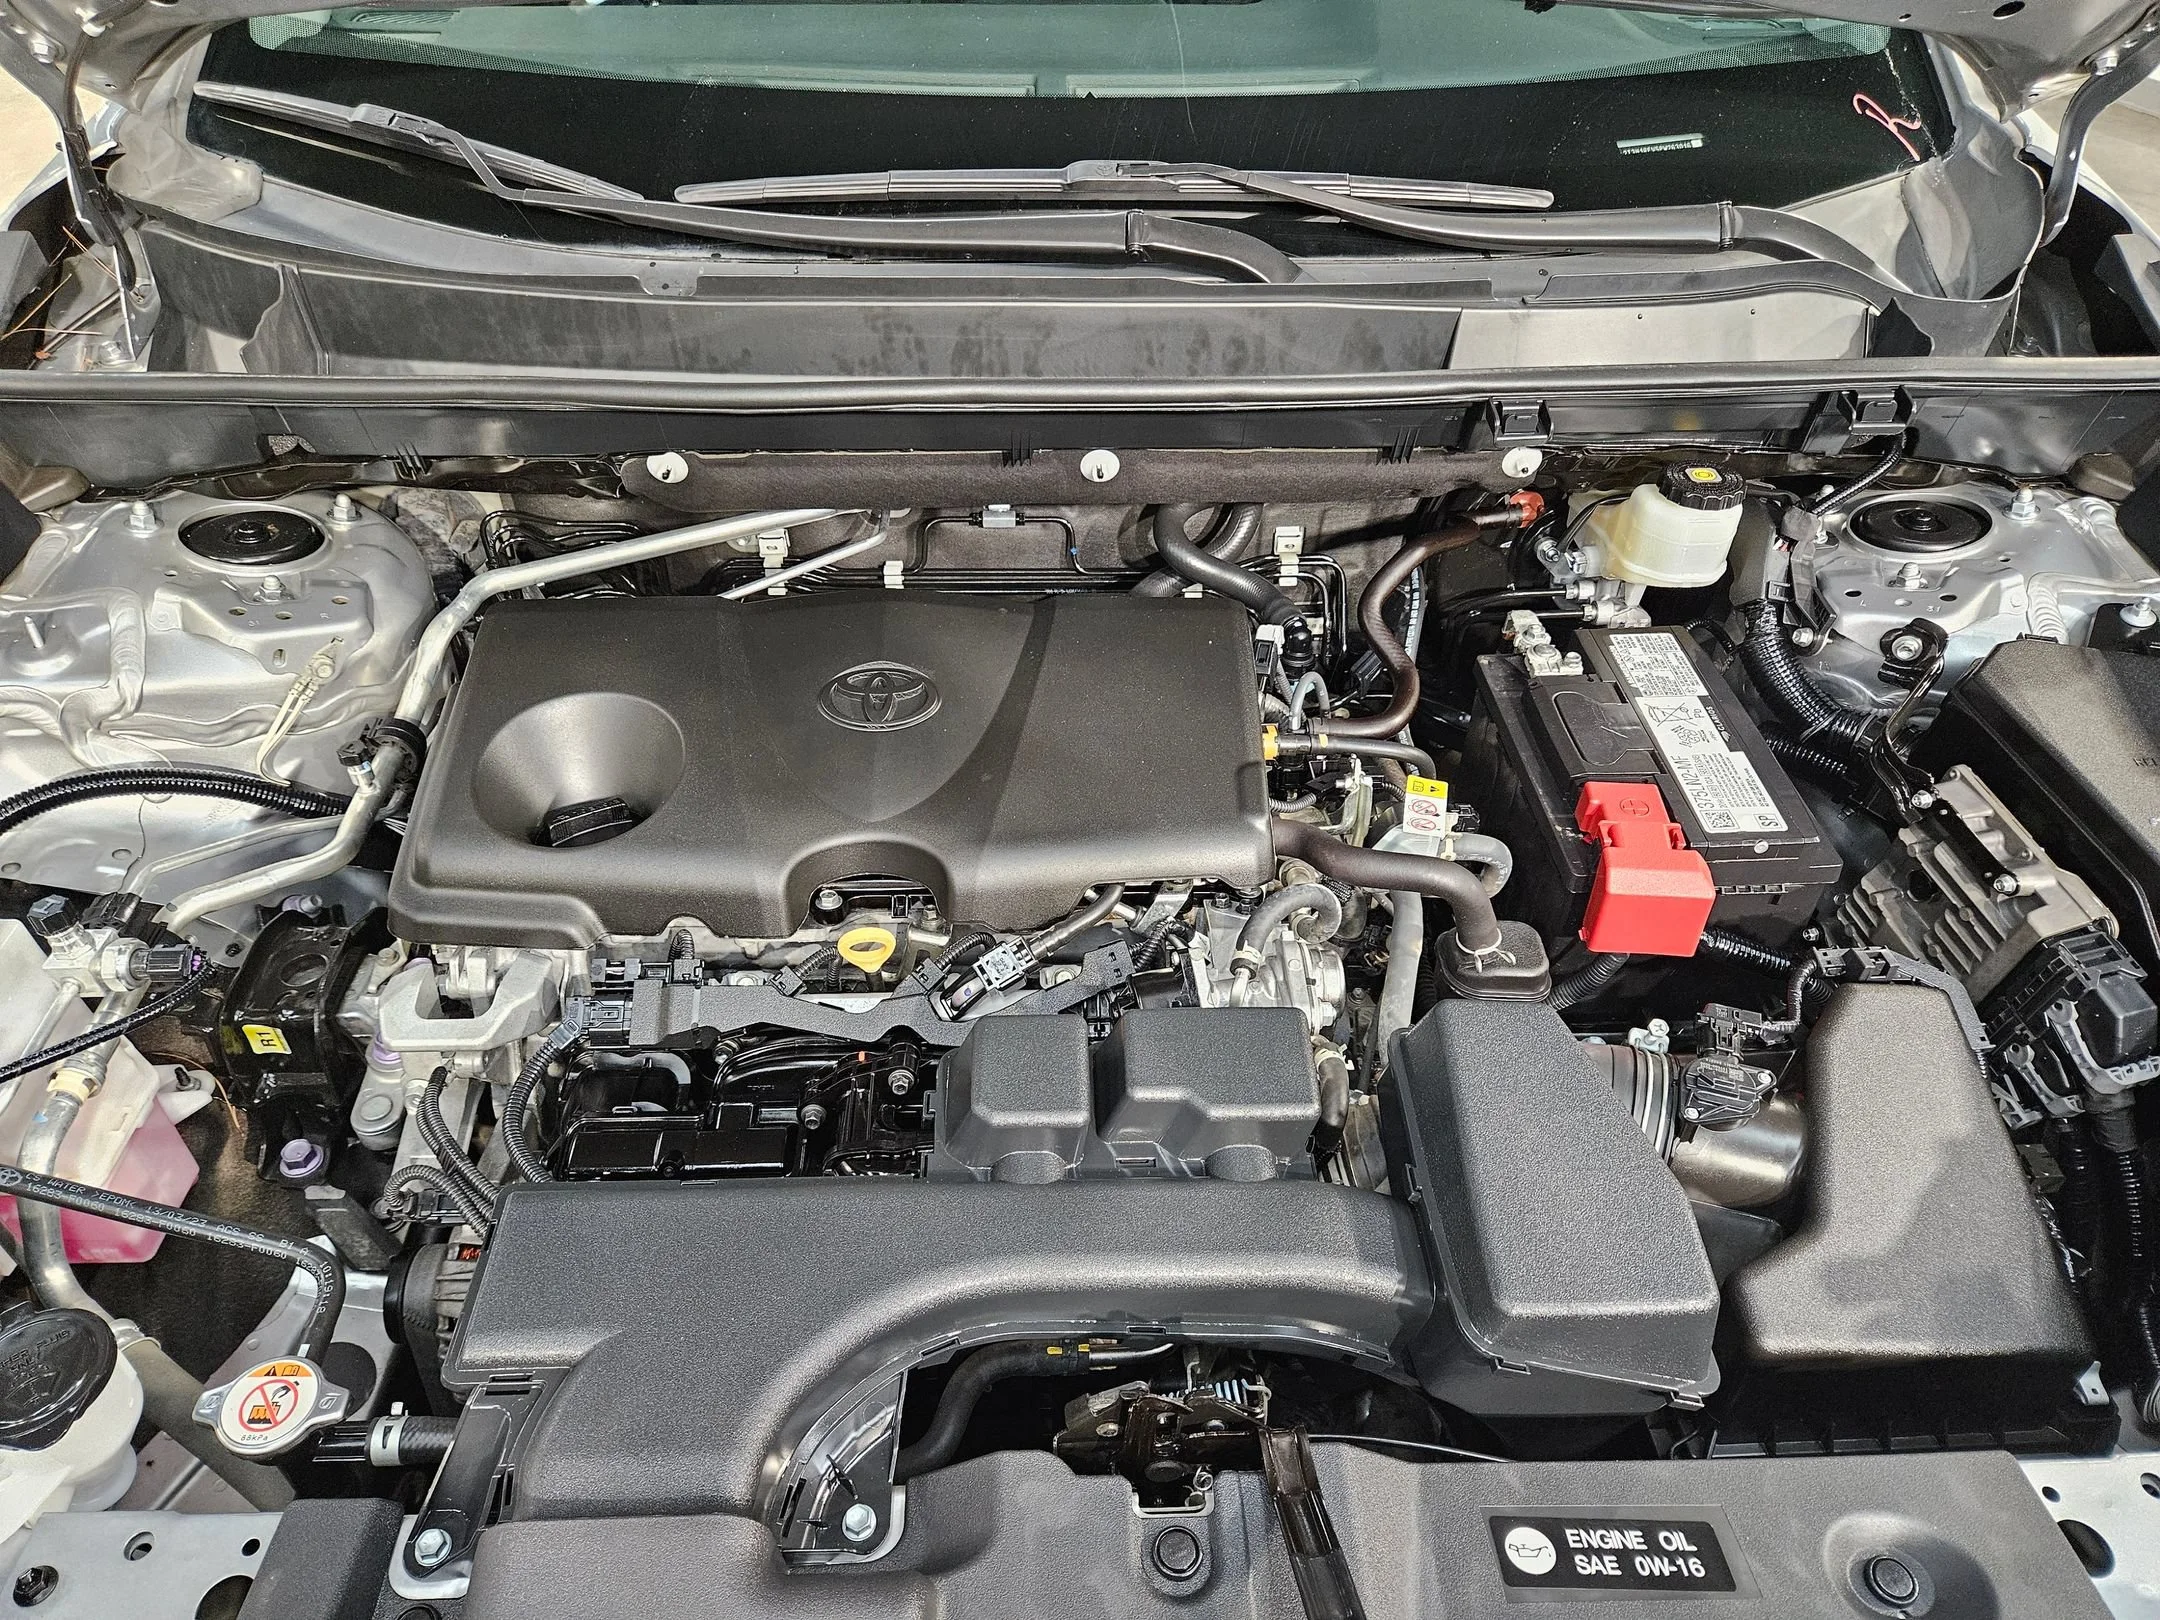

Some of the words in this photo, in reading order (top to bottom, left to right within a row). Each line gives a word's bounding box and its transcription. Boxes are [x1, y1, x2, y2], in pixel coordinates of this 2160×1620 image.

[1758, 815, 1779, 828] SP
[25, 1172, 42, 1183] CS
[49, 1178, 86, 1195] WATER
[25, 1182, 105, 1213] 16283-F0060
[114, 1207, 196, 1237] 16283-F0060
[1564, 1528, 1648, 1550] ENGINE
[1658, 1531, 1698, 1551] OIL
[1574, 1556, 1622, 1576] SAE
[1634, 1556, 1706, 1578] 0W-16
